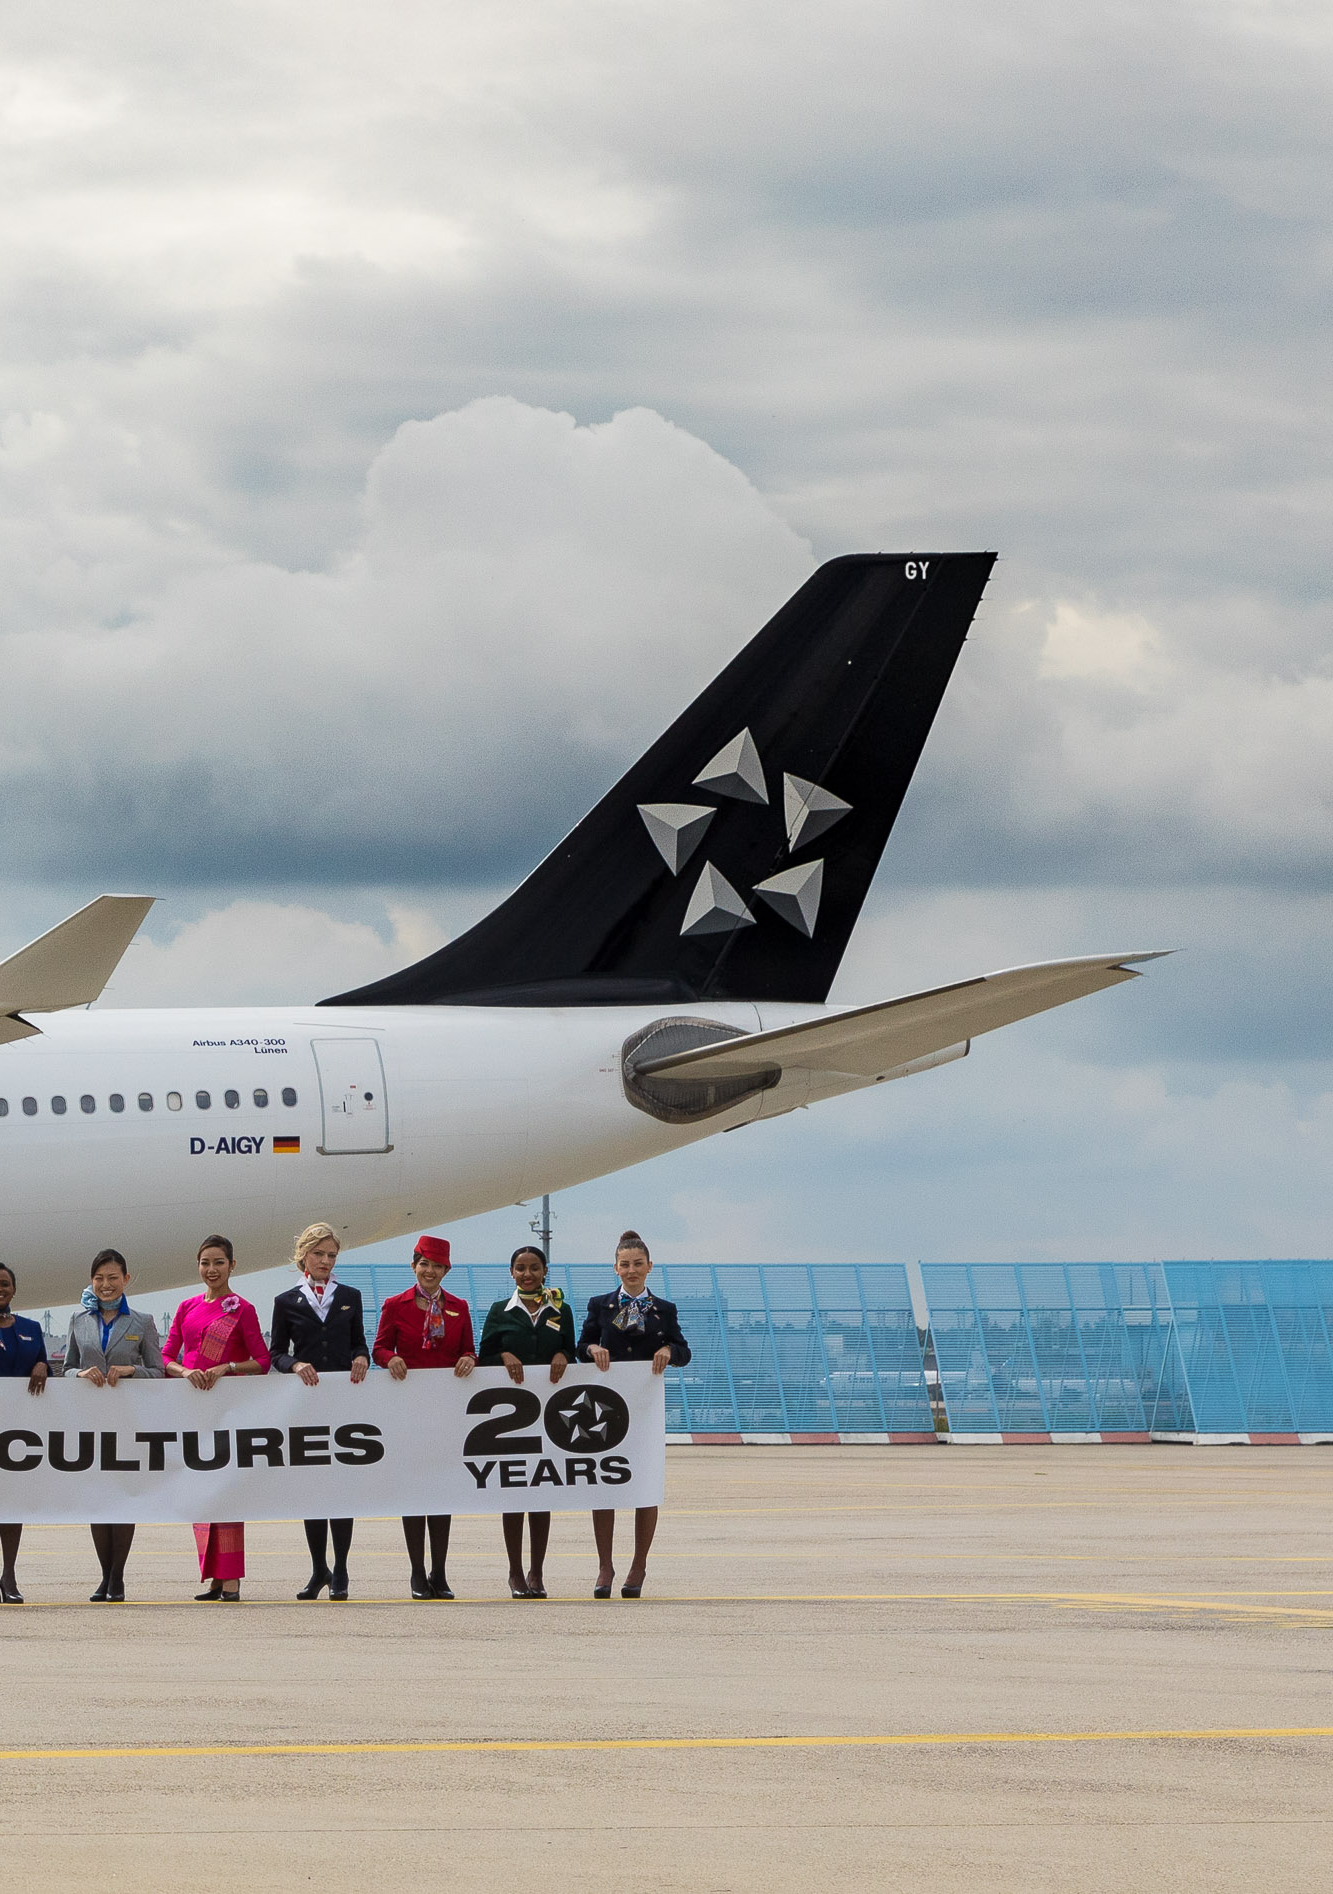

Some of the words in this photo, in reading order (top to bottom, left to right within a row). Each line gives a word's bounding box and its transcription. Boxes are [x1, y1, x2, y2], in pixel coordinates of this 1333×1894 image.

[905, 561, 930, 580] GY
[229, 1038, 286, 1046] A340-300
[254, 1046, 288, 1054] Lünen
[190, 1136, 265, 1155] D-AIGY
[462, 1384, 630, 1457] 20
[463, 1455, 632, 1489] YEARS
